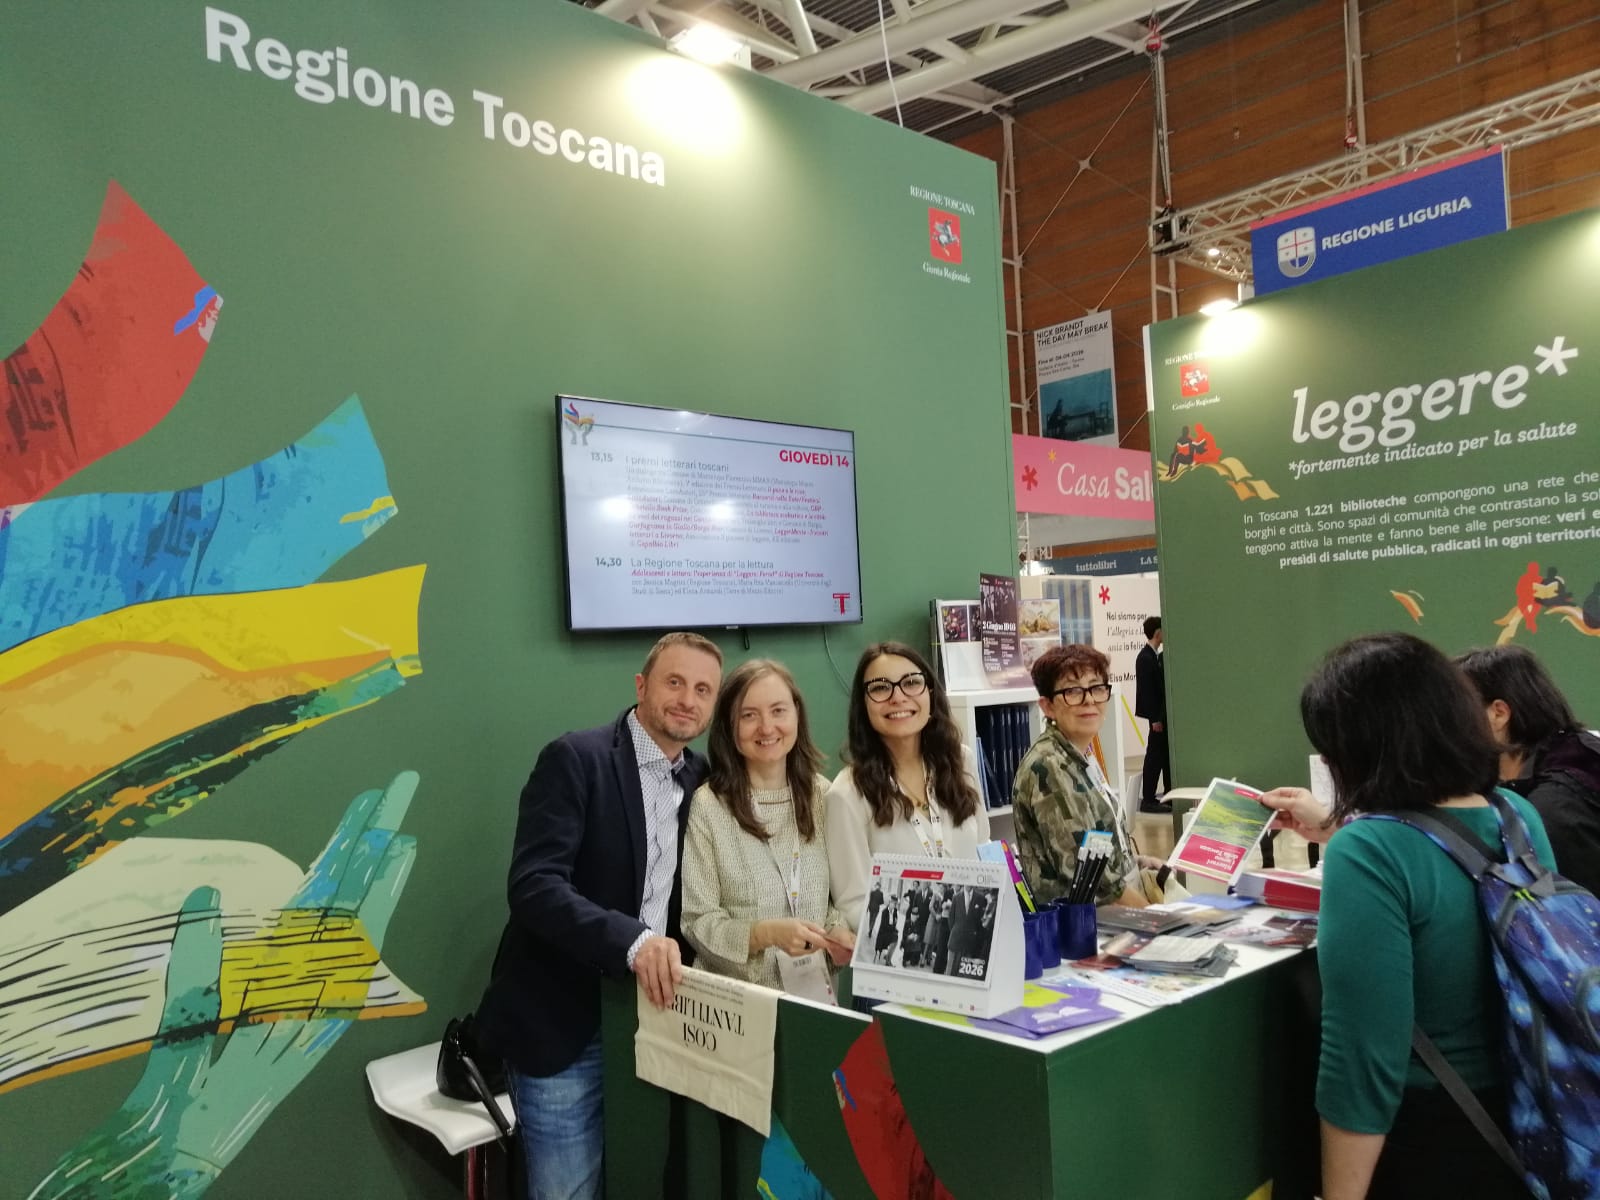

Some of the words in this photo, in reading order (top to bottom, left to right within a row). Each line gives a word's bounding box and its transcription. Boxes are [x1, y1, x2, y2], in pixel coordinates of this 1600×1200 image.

[205, 6, 455, 127] Regione
[473, 90, 665, 187] Toscana
[910, 184, 943, 206] REGIONE
[944, 195, 976, 216] TOSCANA
[1322, 217, 1395, 250] REGIONE
[1399, 196, 1472, 229] LIGURIA
[1037, 329, 1054, 340] NICK
[1055, 320, 1085, 335] BRANDT
[1038, 338, 1052, 348] THE
[1053, 334, 1067, 344] DAY
[1067, 330, 1084, 341] MAY
[1085, 321, 1109, 335] BREAK
[1384, 440, 1454, 463] indicato
[1457, 437, 1489, 456] per
[1494, 429, 1513, 446] la
[1517, 421, 1578, 443] salute
[631, 456, 659, 467] premi
[661, 456, 697, 470] letterari
[698, 462, 729, 473] toscani
[779, 449, 833, 467] GIOVEDÌ
[836, 455, 849, 468] 14
[1057, 463, 1110, 499] Casa
[1114, 467, 1154, 502] Sal
[1243, 513, 1254, 524] In
[1258, 509, 1299, 523] Toscana
[1305, 503, 1334, 517] 1.221
[1341, 495, 1407, 513] biblioteche
[1414, 485, 1496, 504] compongono
[1503, 481, 1529, 493] una
[1537, 476, 1565, 489] rete
[1573, 471, 1600, 485] che
[1244, 526, 1277, 540] borghi
[1279, 526, 1286, 536] e
[1289, 522, 1314, 535] città.
[1317, 520, 1345, 531] Sono
[1348, 515, 1376, 530] spazi
[1380, 512, 1390, 524] di
[1394, 506, 1450, 524] comunità
[1454, 504, 1476, 517] che
[1481, 495, 1560, 514] contrastano
[1564, 491, 1577, 504] la
[1245, 541, 1286, 556] tengono
[1290, 537, 1319, 550] attiva
[1323, 536, 1333, 546] la
[1337, 532, 1373, 545] mente
[1377, 532, 1385, 541] e
[1390, 527, 1424, 540] fanno
[1429, 524, 1460, 536] bene
[1465, 520, 1487, 532] alle
[1493, 514, 1551, 532] persone:
[1556, 508, 1586, 523] veri
[1592, 509, 1600, 519] e
[1319, 551, 1330, 563] di
[1332, 548, 1369, 562] salute
[1372, 543, 1428, 560] pubblica,
[1431, 537, 1481, 553] radicati
[1484, 535, 1498, 548] in
[1501, 531, 1532, 549] ogni
[595, 556, 622, 568] 14,30
[631, 558, 642, 568] La
[644, 558, 683, 570] Regione
[686, 559, 720, 569] Toscana
[722, 561, 736, 570] per
[738, 559, 745, 569] la
[747, 559, 774, 569] lettura
[1076, 559, 1117, 572] tuttolibri
[1106, 611, 1117, 620] Noi
[1117, 612, 1136, 621] siamo
[1137, 613, 1147, 623] per
[1109, 674, 1123, 683] Elsa
[958, 962, 984, 977] 2026
[699, 1001, 745, 1037] TANTI
